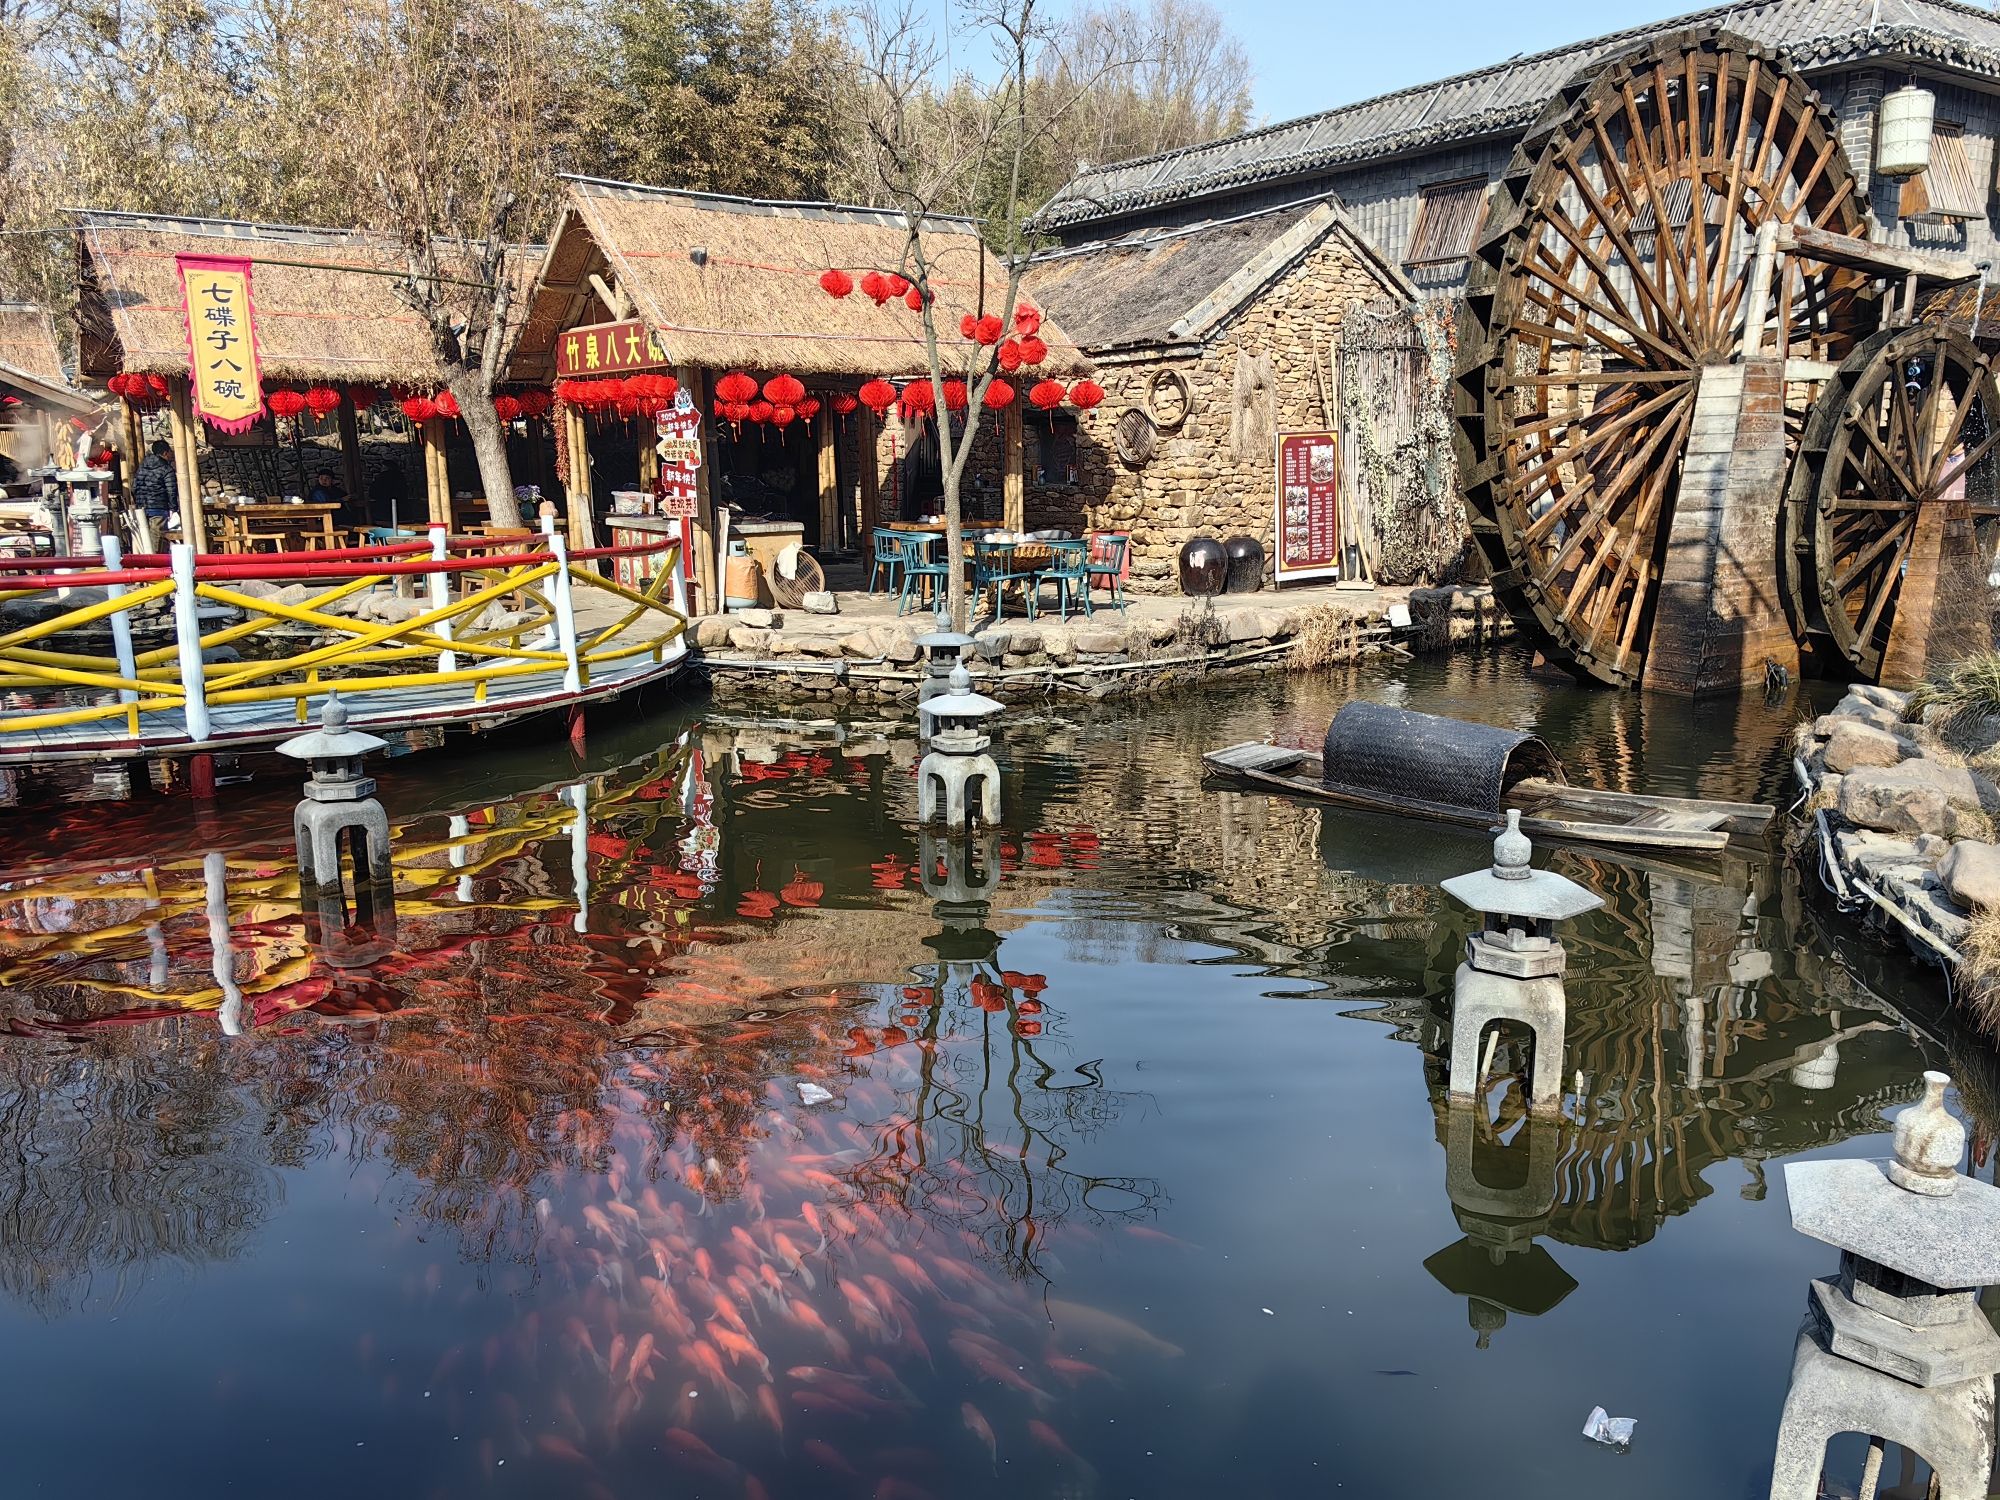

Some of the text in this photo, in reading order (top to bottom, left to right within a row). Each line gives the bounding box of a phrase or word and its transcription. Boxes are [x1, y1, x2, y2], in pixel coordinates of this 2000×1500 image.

[201, 282, 246, 400] 七碟子八碗
[661, 412, 677, 421] 2024
